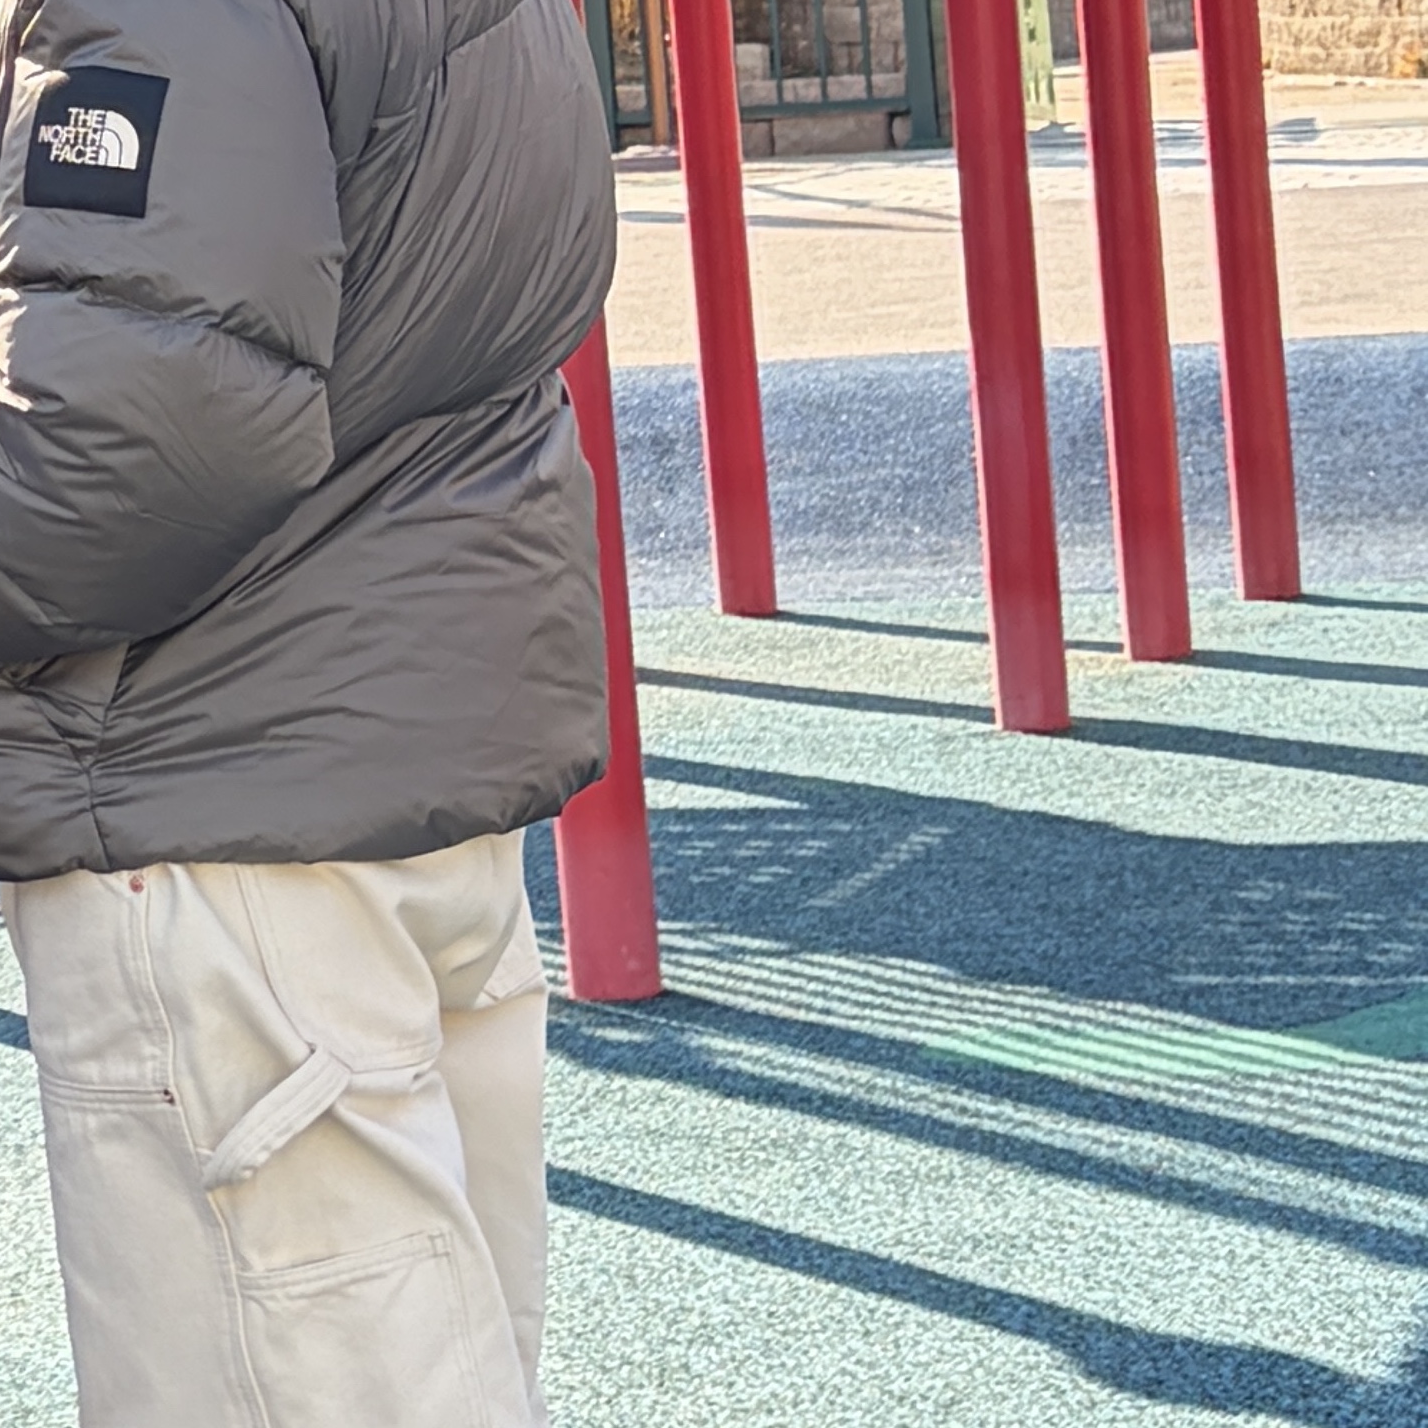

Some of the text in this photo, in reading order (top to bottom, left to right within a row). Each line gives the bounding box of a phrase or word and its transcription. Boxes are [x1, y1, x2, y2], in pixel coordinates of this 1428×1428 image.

[68, 107, 106, 128] THE
[38, 125, 102, 146] NORTH
[50, 144, 99, 165] FACE
